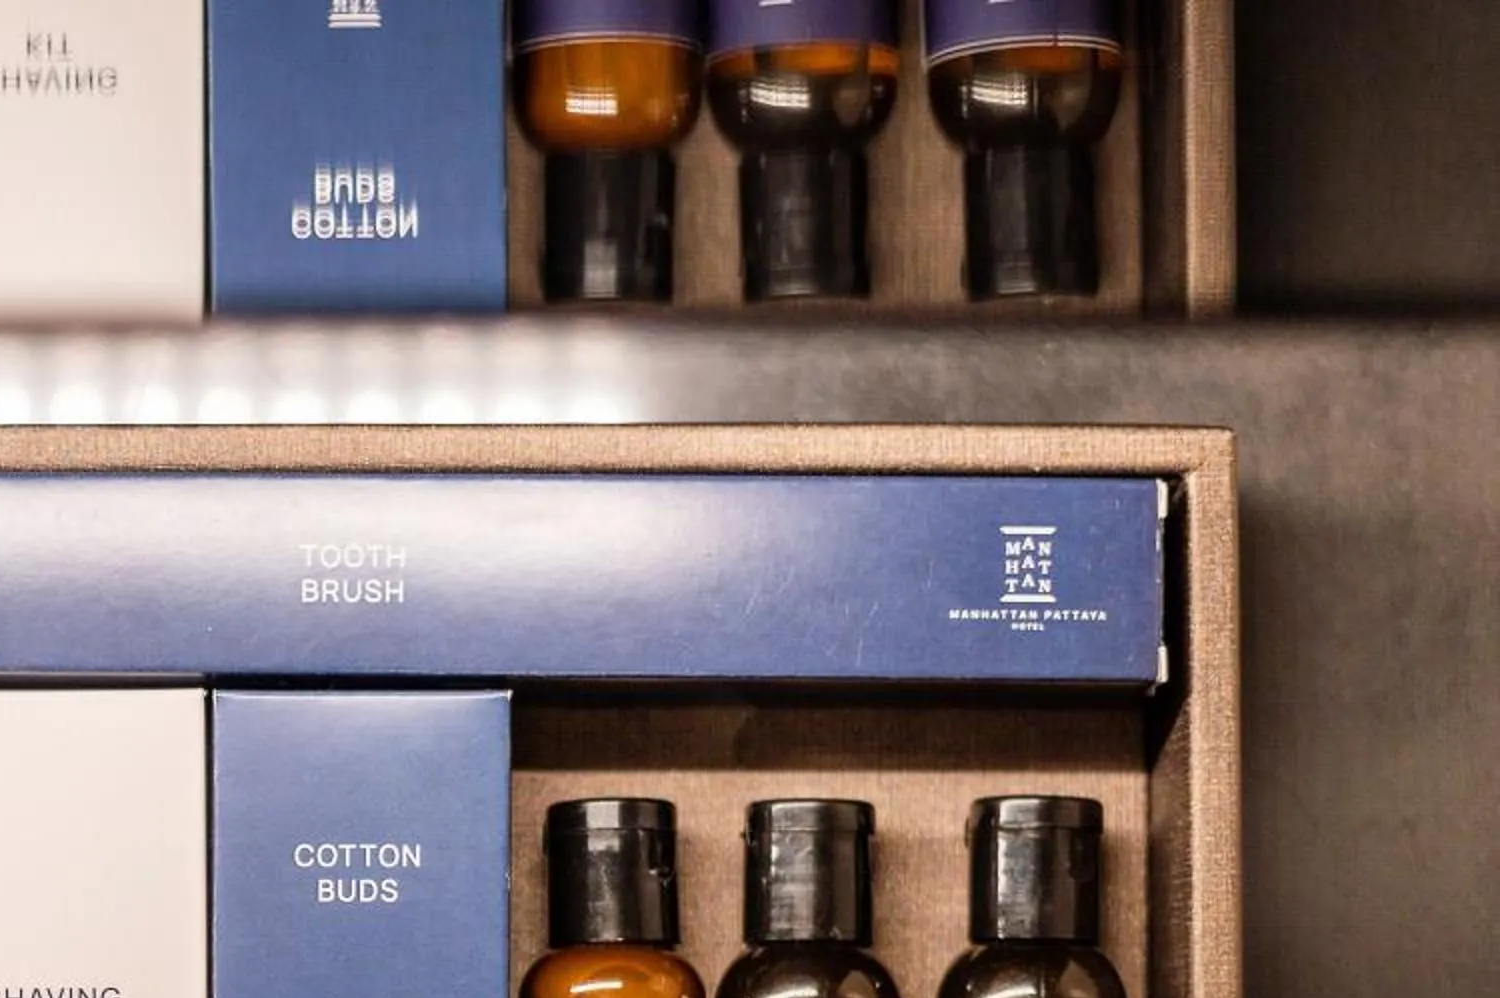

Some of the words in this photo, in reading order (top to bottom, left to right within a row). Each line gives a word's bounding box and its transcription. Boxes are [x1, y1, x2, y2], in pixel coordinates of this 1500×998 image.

[299, 543, 406, 569] TOOTH
[1005, 536, 1052, 556] MAN
[1005, 555, 1052, 575] HAT
[301, 578, 404, 604] BRUSH
[1004, 574, 1052, 593] TAN
[949, 609, 1039, 621] MANHATTAN
[1044, 609, 1107, 621] PATTAYA
[293, 843, 422, 868] COTTON
[317, 878, 399, 903] BUDS
